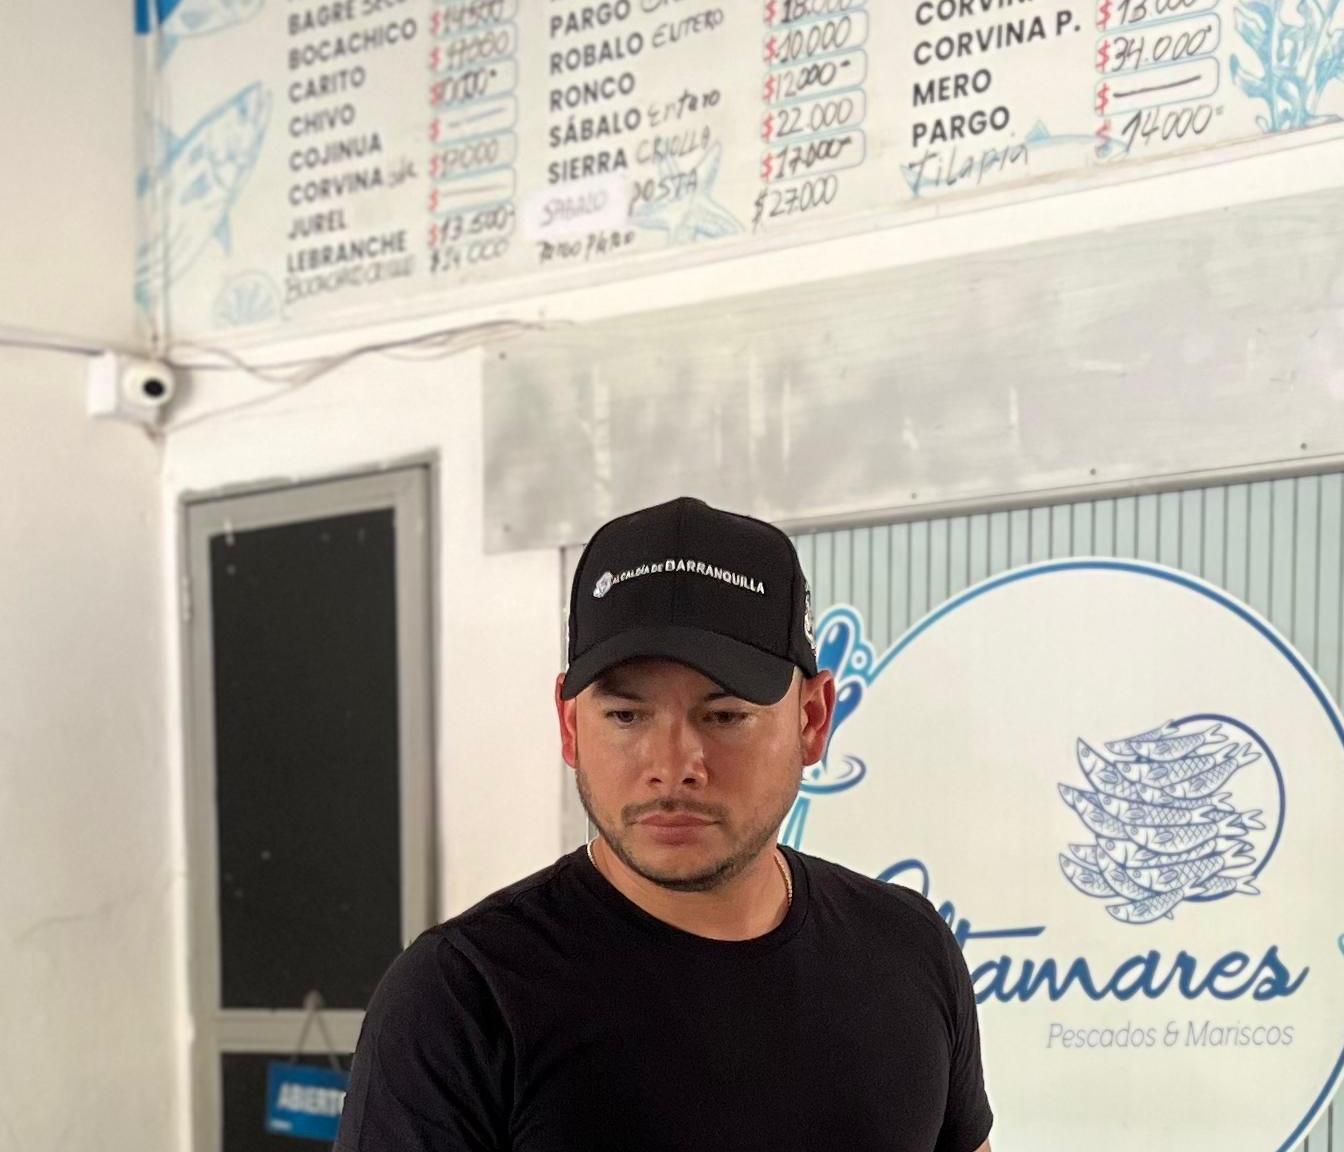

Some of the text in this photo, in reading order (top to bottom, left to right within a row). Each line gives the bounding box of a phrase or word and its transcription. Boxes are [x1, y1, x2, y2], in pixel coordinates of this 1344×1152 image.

[288, 1, 355, 36] BAGRE
[550, 0, 631, 38] PARGO
[915, 0, 1033, 26] CORV
[288, 18, 418, 71] BOCACHICO
[550, 32, 644, 75] ROBALO
[913, 10, 1081, 66] CORVINA P.
[288, 66, 366, 104] CARITO
[550, 72, 636, 112] RONCO
[912, 68, 992, 107] MERO
[288, 103, 356, 138] CHIVO
[549, 108, 641, 148] SÁBALO
[912, 105, 1010, 148] PARGO
[288, 132, 382, 172] COJINUA
[548, 148, 628, 184] SIERRA
[288, 167, 384, 206] CORVINA
[287, 209, 347, 240] JUREL
[287, 230, 407, 273] LEBRANCHE
[665, 559, 765, 595] BARRANQUILLA
[1046, 1019, 1294, 1050] Pescados & Mariscos
